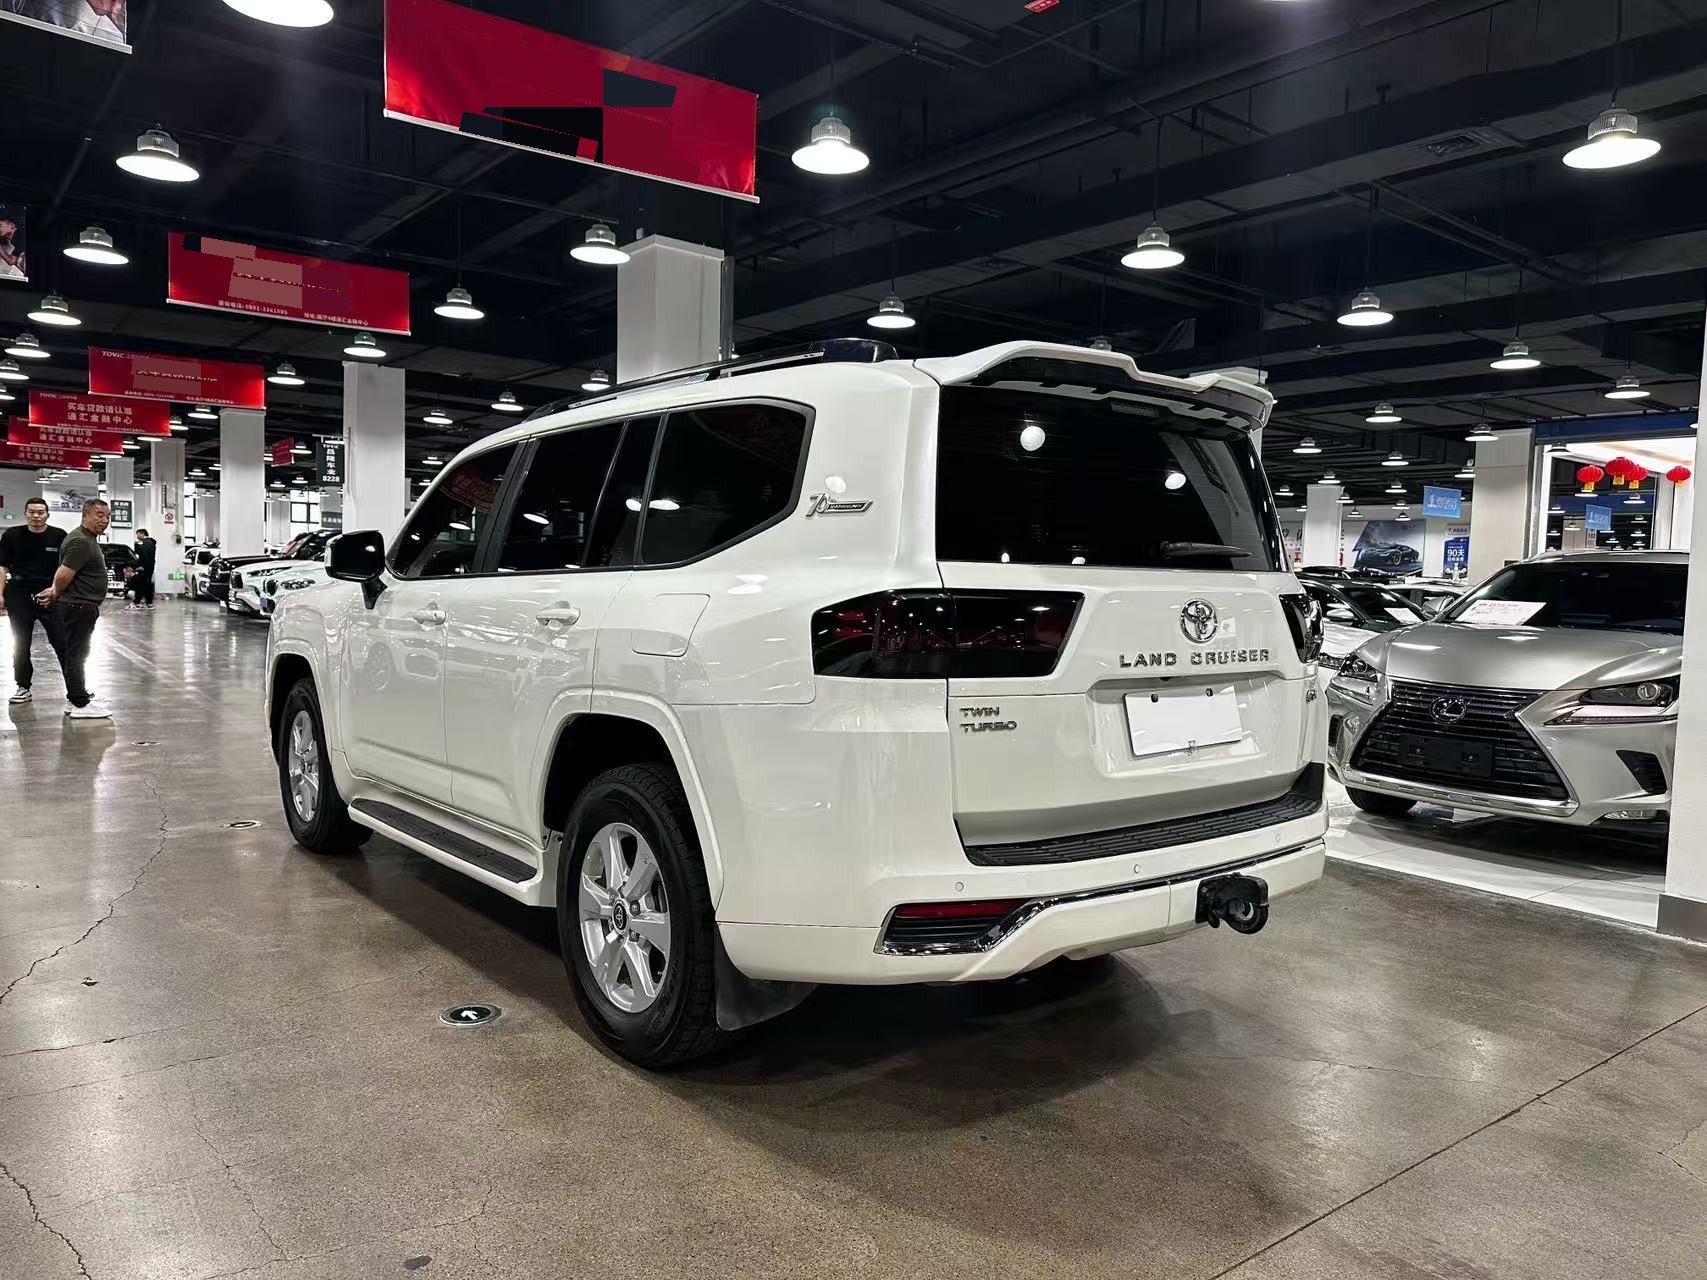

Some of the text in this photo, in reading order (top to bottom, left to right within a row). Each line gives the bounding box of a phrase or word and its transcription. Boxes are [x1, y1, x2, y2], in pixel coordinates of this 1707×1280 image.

[67, 401, 133, 416] 买车贷款请认准
[67, 411, 133, 426] 通汇金融中心
[1119, 648, 1270, 668] LAND CRUISER
[959, 706, 1000, 717] TWIN
[959, 720, 1018, 733] TURBO
